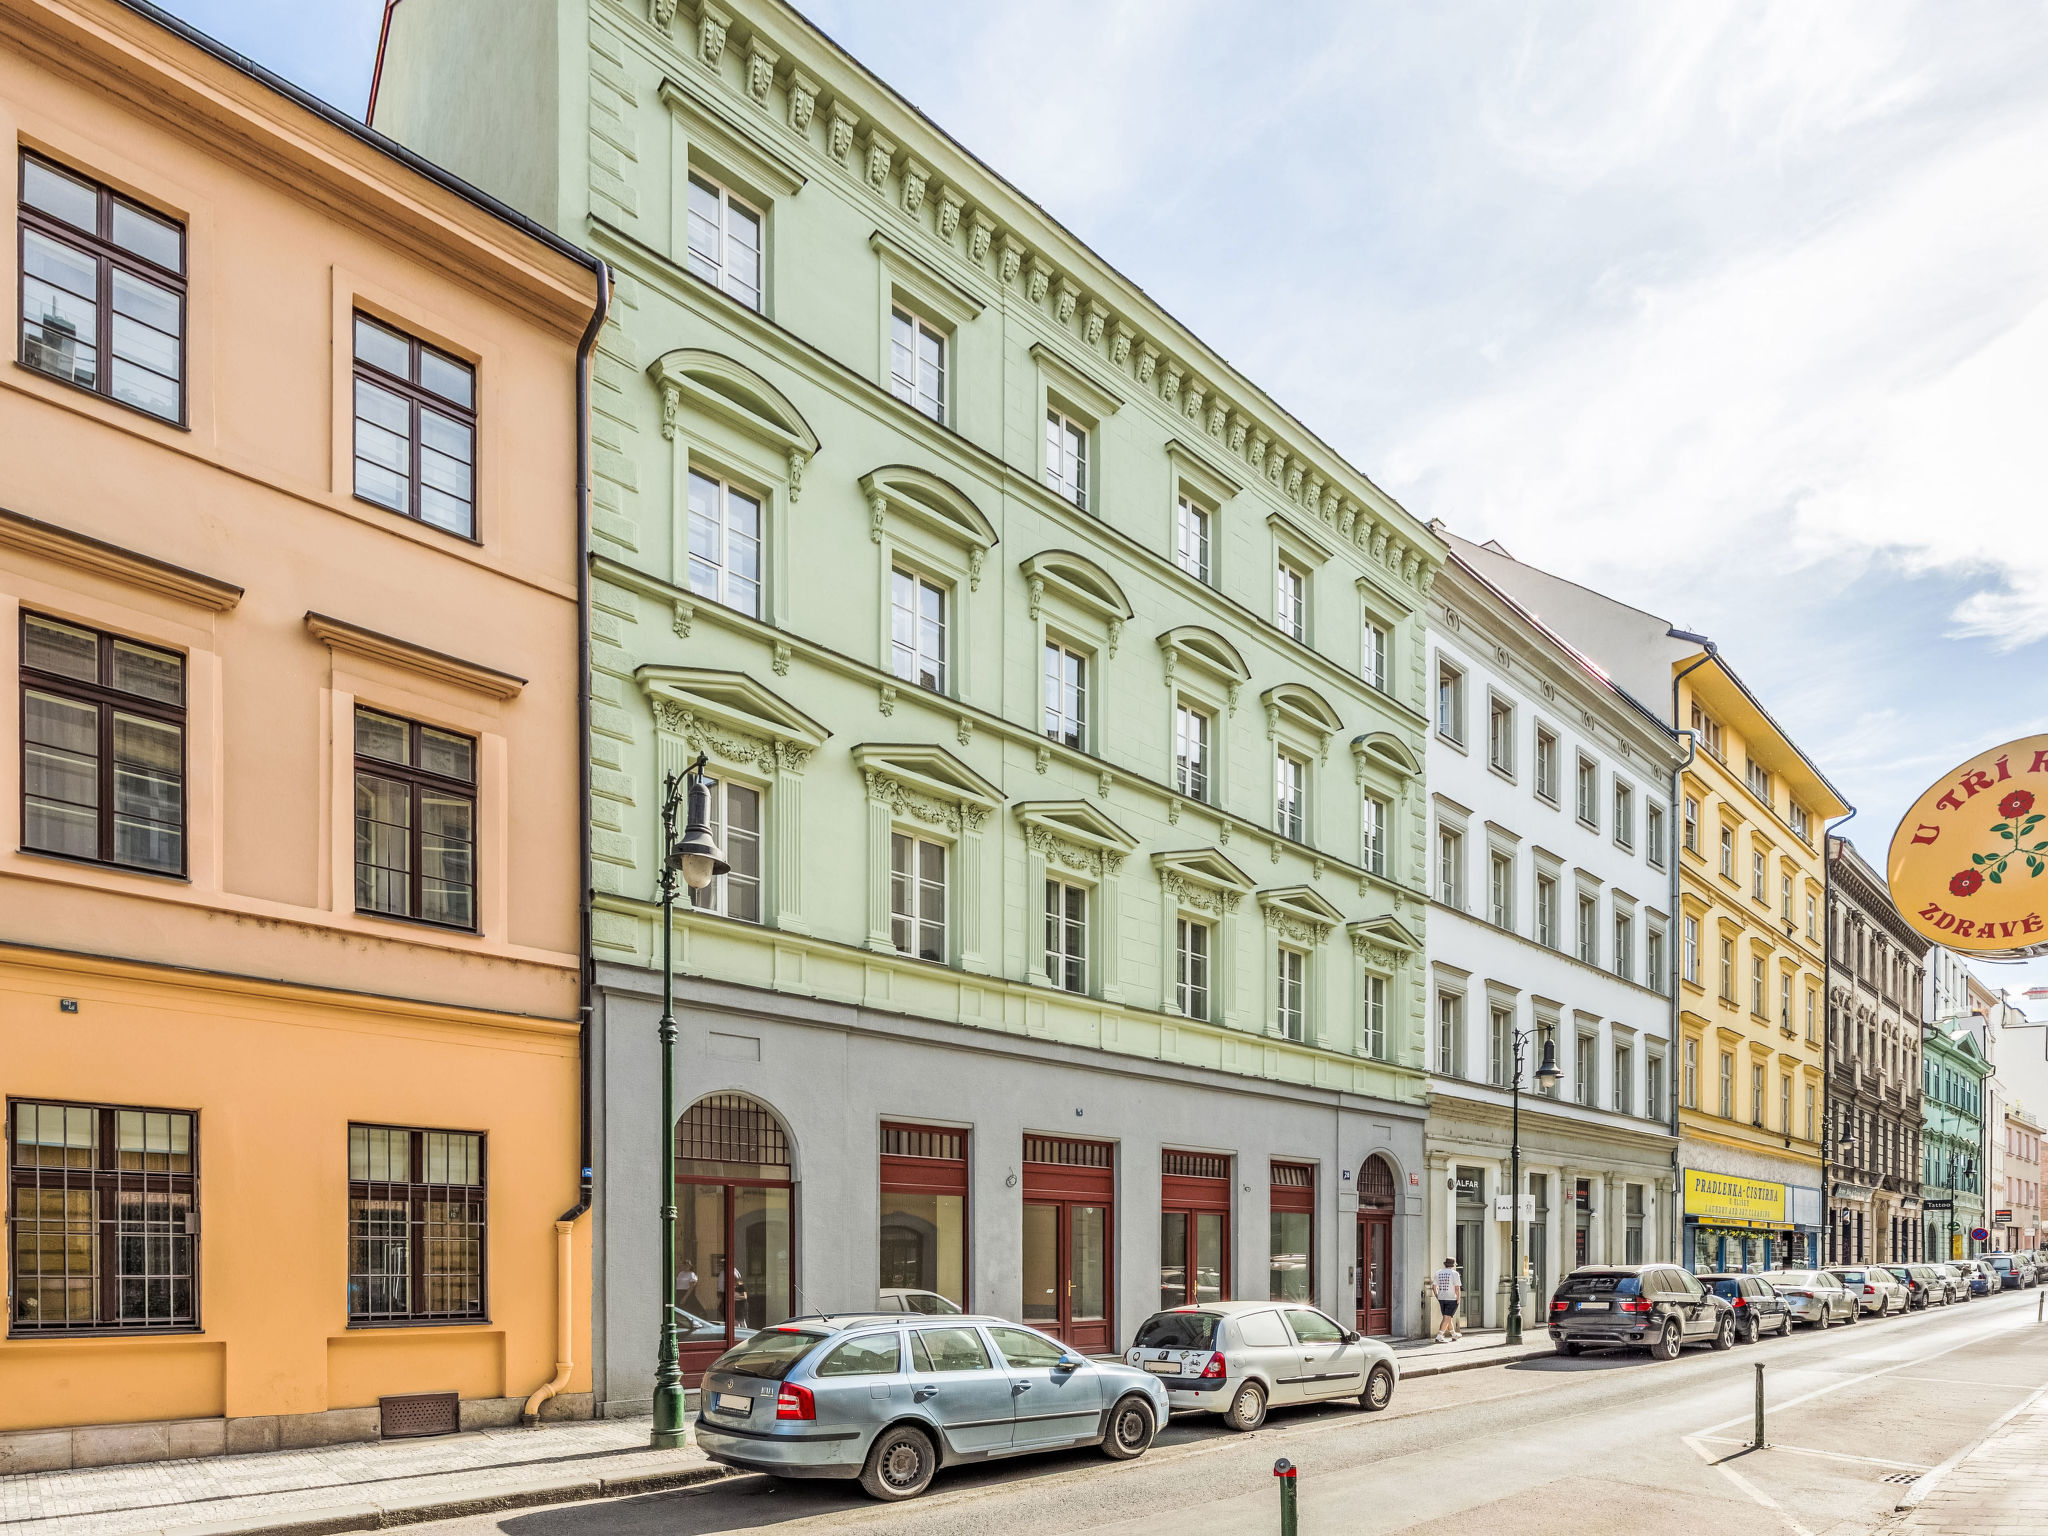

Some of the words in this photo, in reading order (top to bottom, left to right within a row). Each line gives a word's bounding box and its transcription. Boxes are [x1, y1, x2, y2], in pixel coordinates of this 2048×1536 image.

[1911, 824, 1940, 845] U
[1936, 754, 2012, 811] TŘÍ
[1918, 903, 2044, 938] ZDRAVÉ
